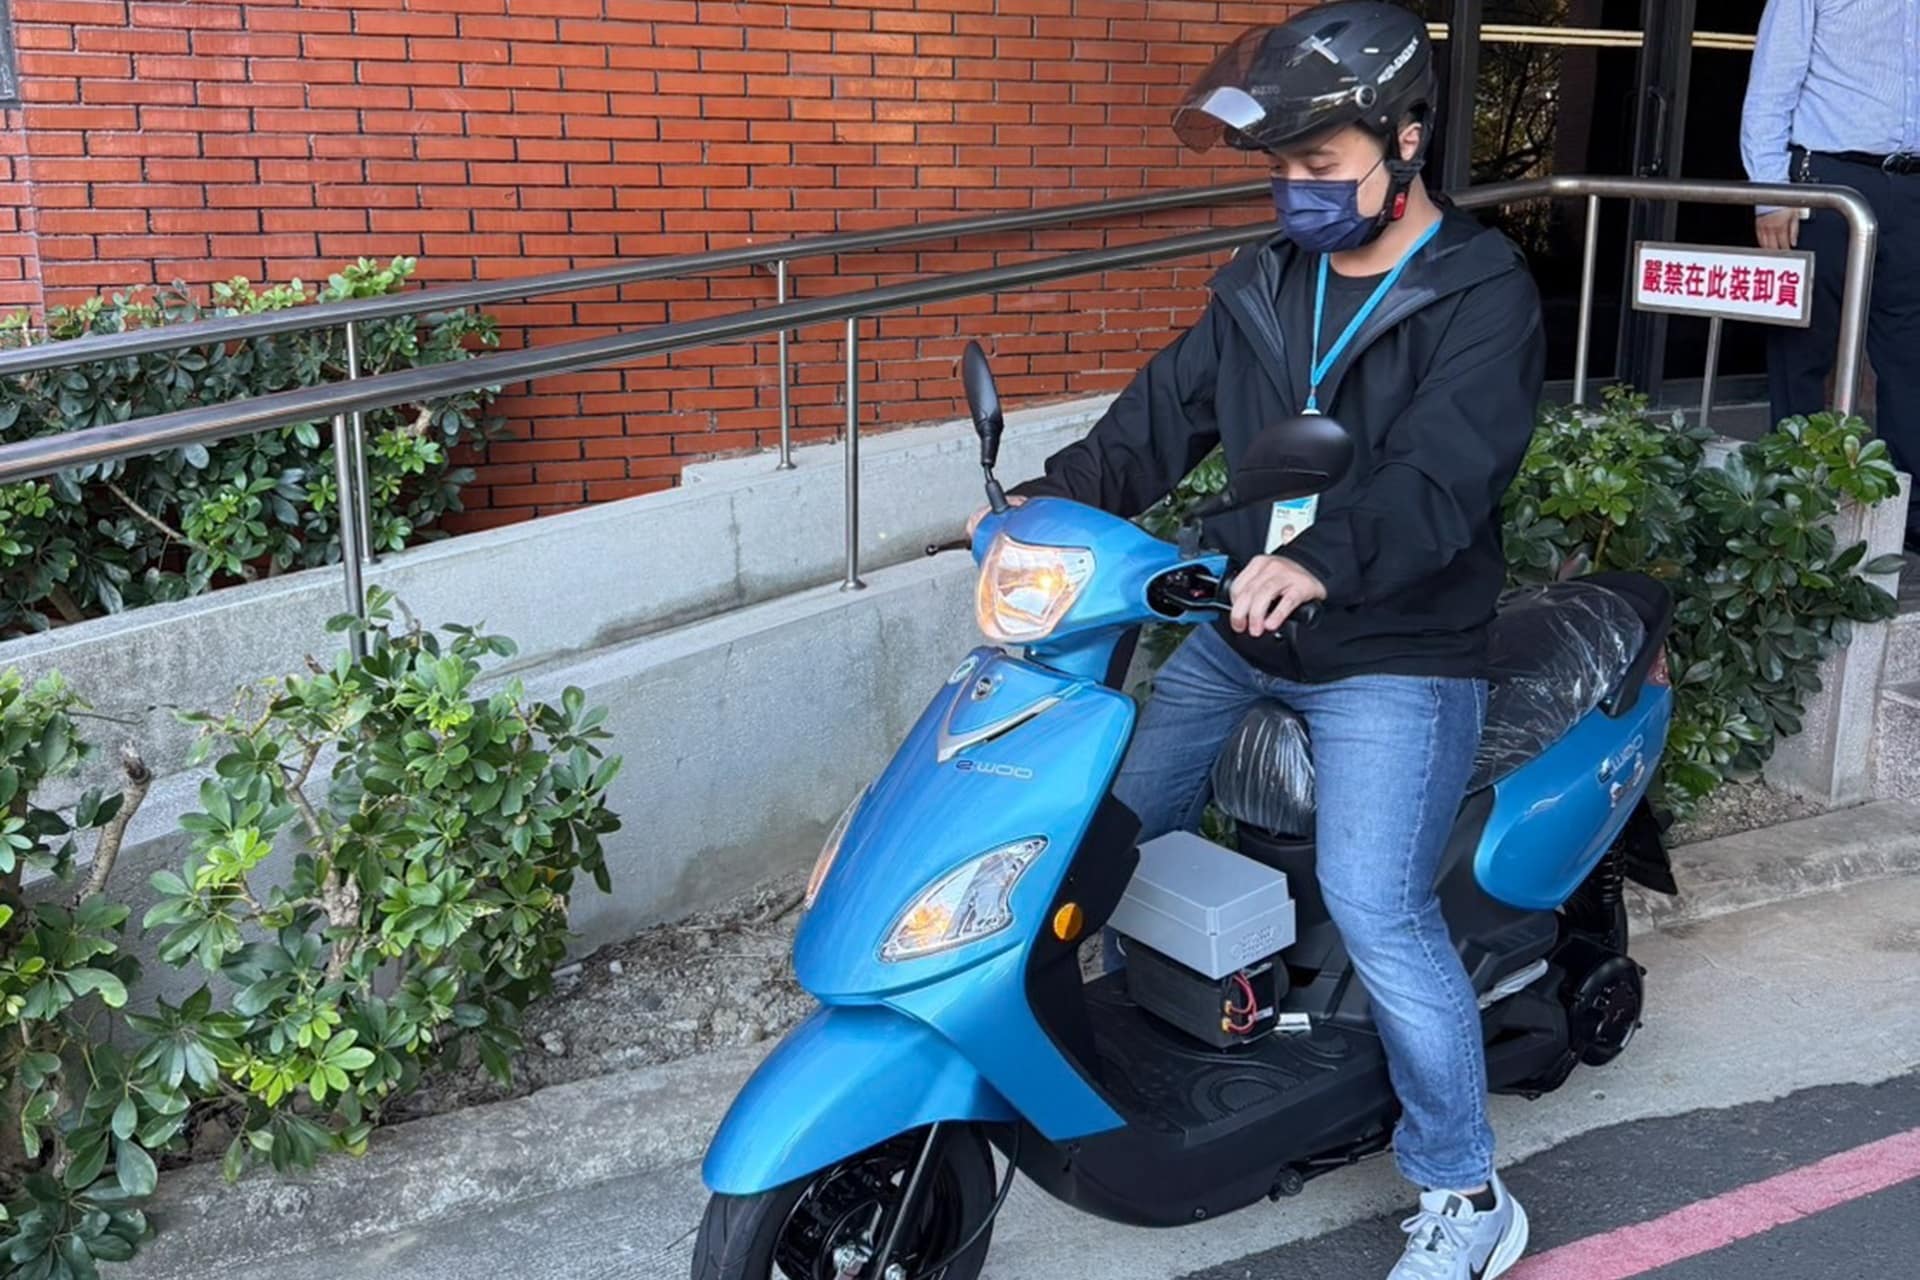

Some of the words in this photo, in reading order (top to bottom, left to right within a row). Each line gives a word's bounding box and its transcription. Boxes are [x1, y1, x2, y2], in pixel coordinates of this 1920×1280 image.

[1642, 259, 1800, 307] 嚴禁在此裝卸貨
